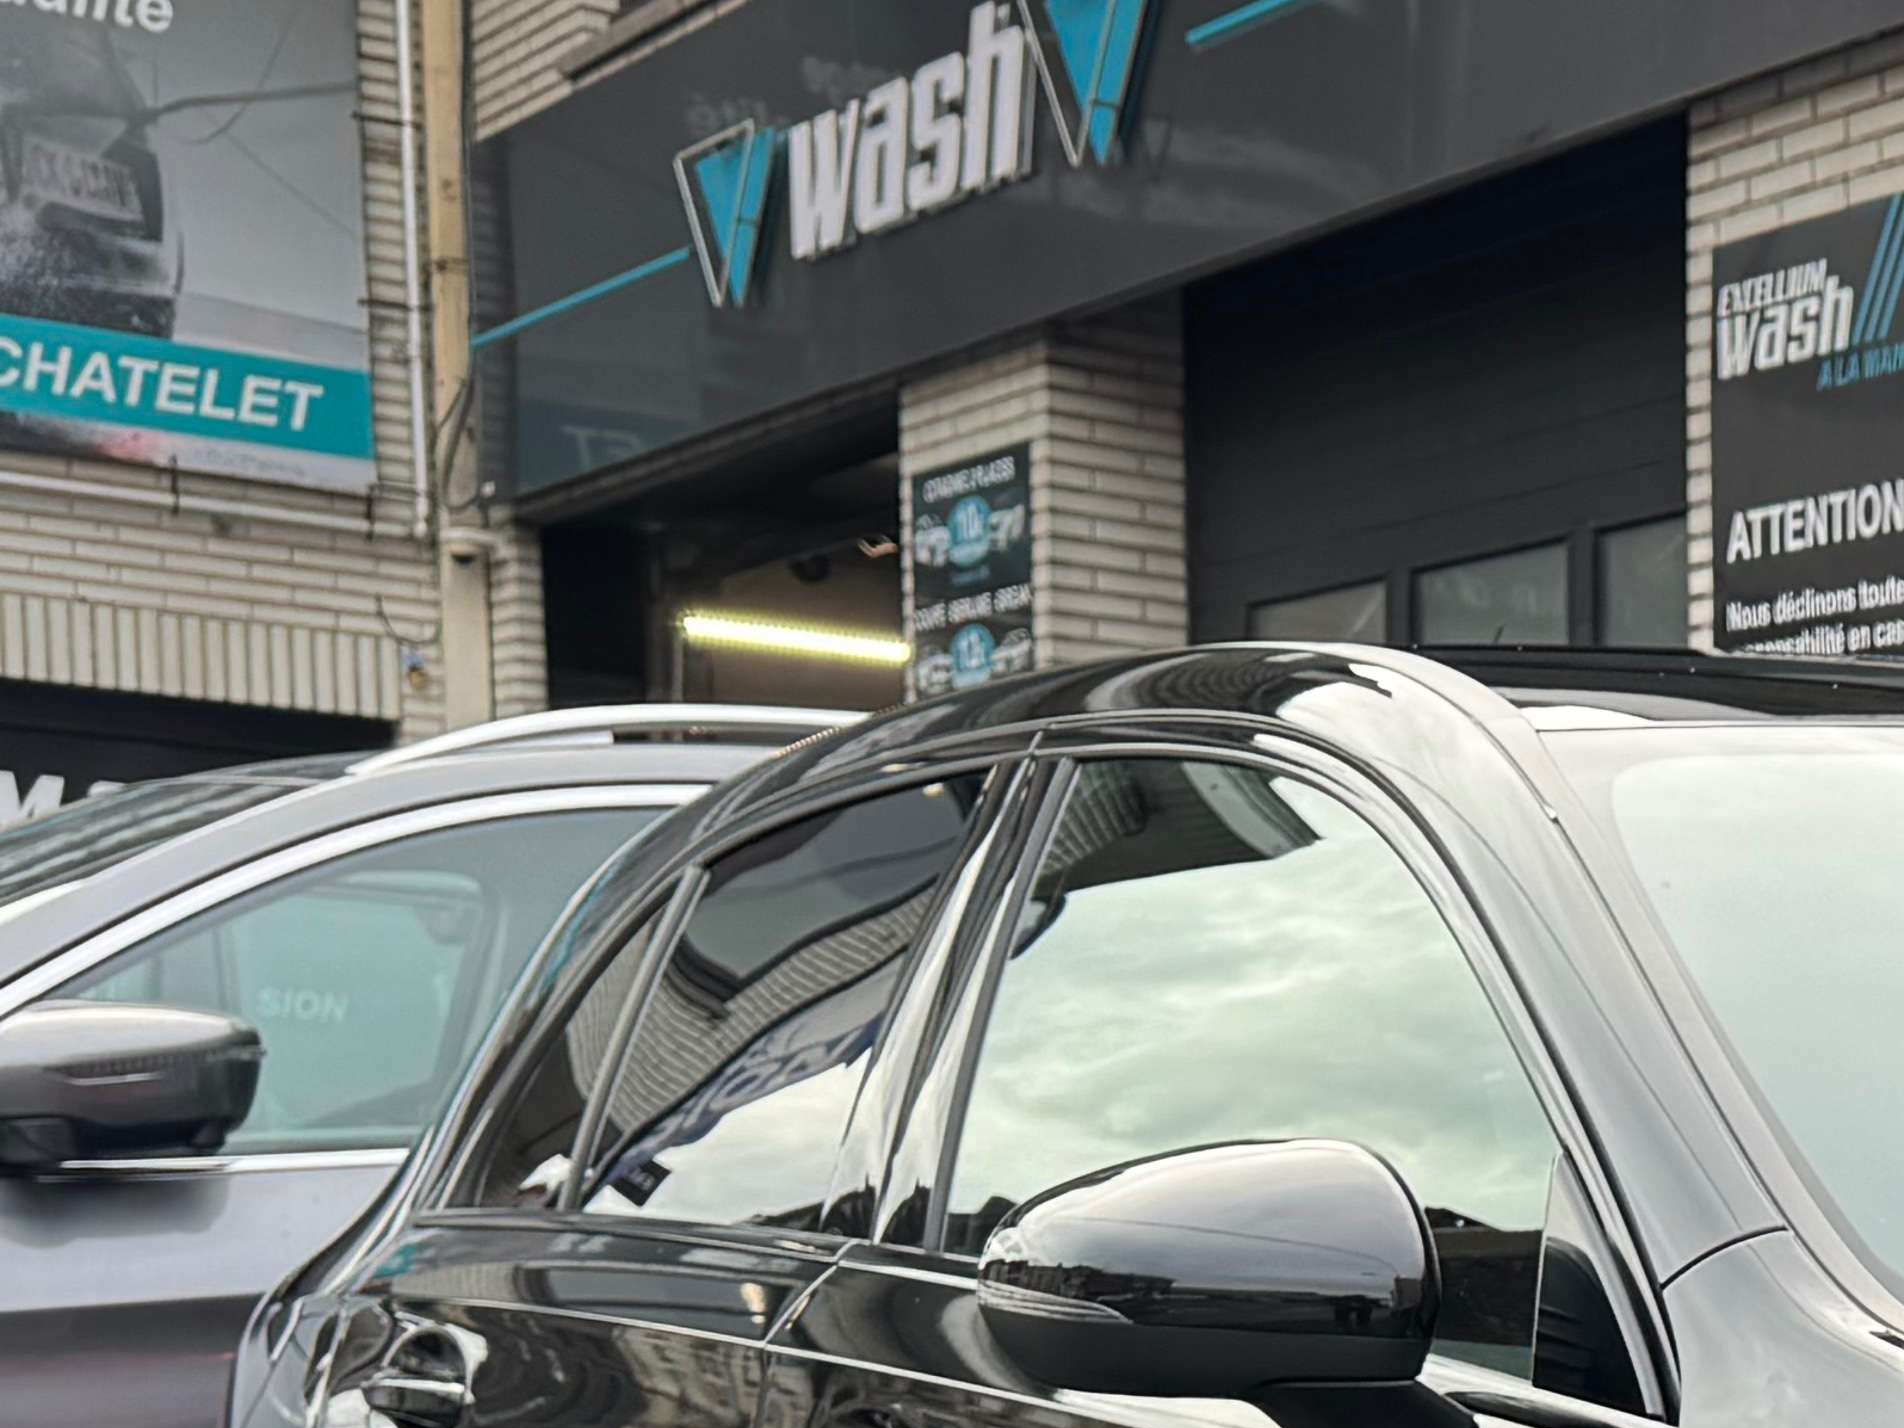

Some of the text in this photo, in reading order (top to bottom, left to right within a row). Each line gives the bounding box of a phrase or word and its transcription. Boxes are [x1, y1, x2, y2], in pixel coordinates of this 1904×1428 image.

[788, 0, 1028, 260] wash
[1716, 275, 1854, 381] wash
[1726, 601, 1771, 632] Nous
[1772, 587, 1857, 624] déclinons
[1847, 625, 1871, 651] en
